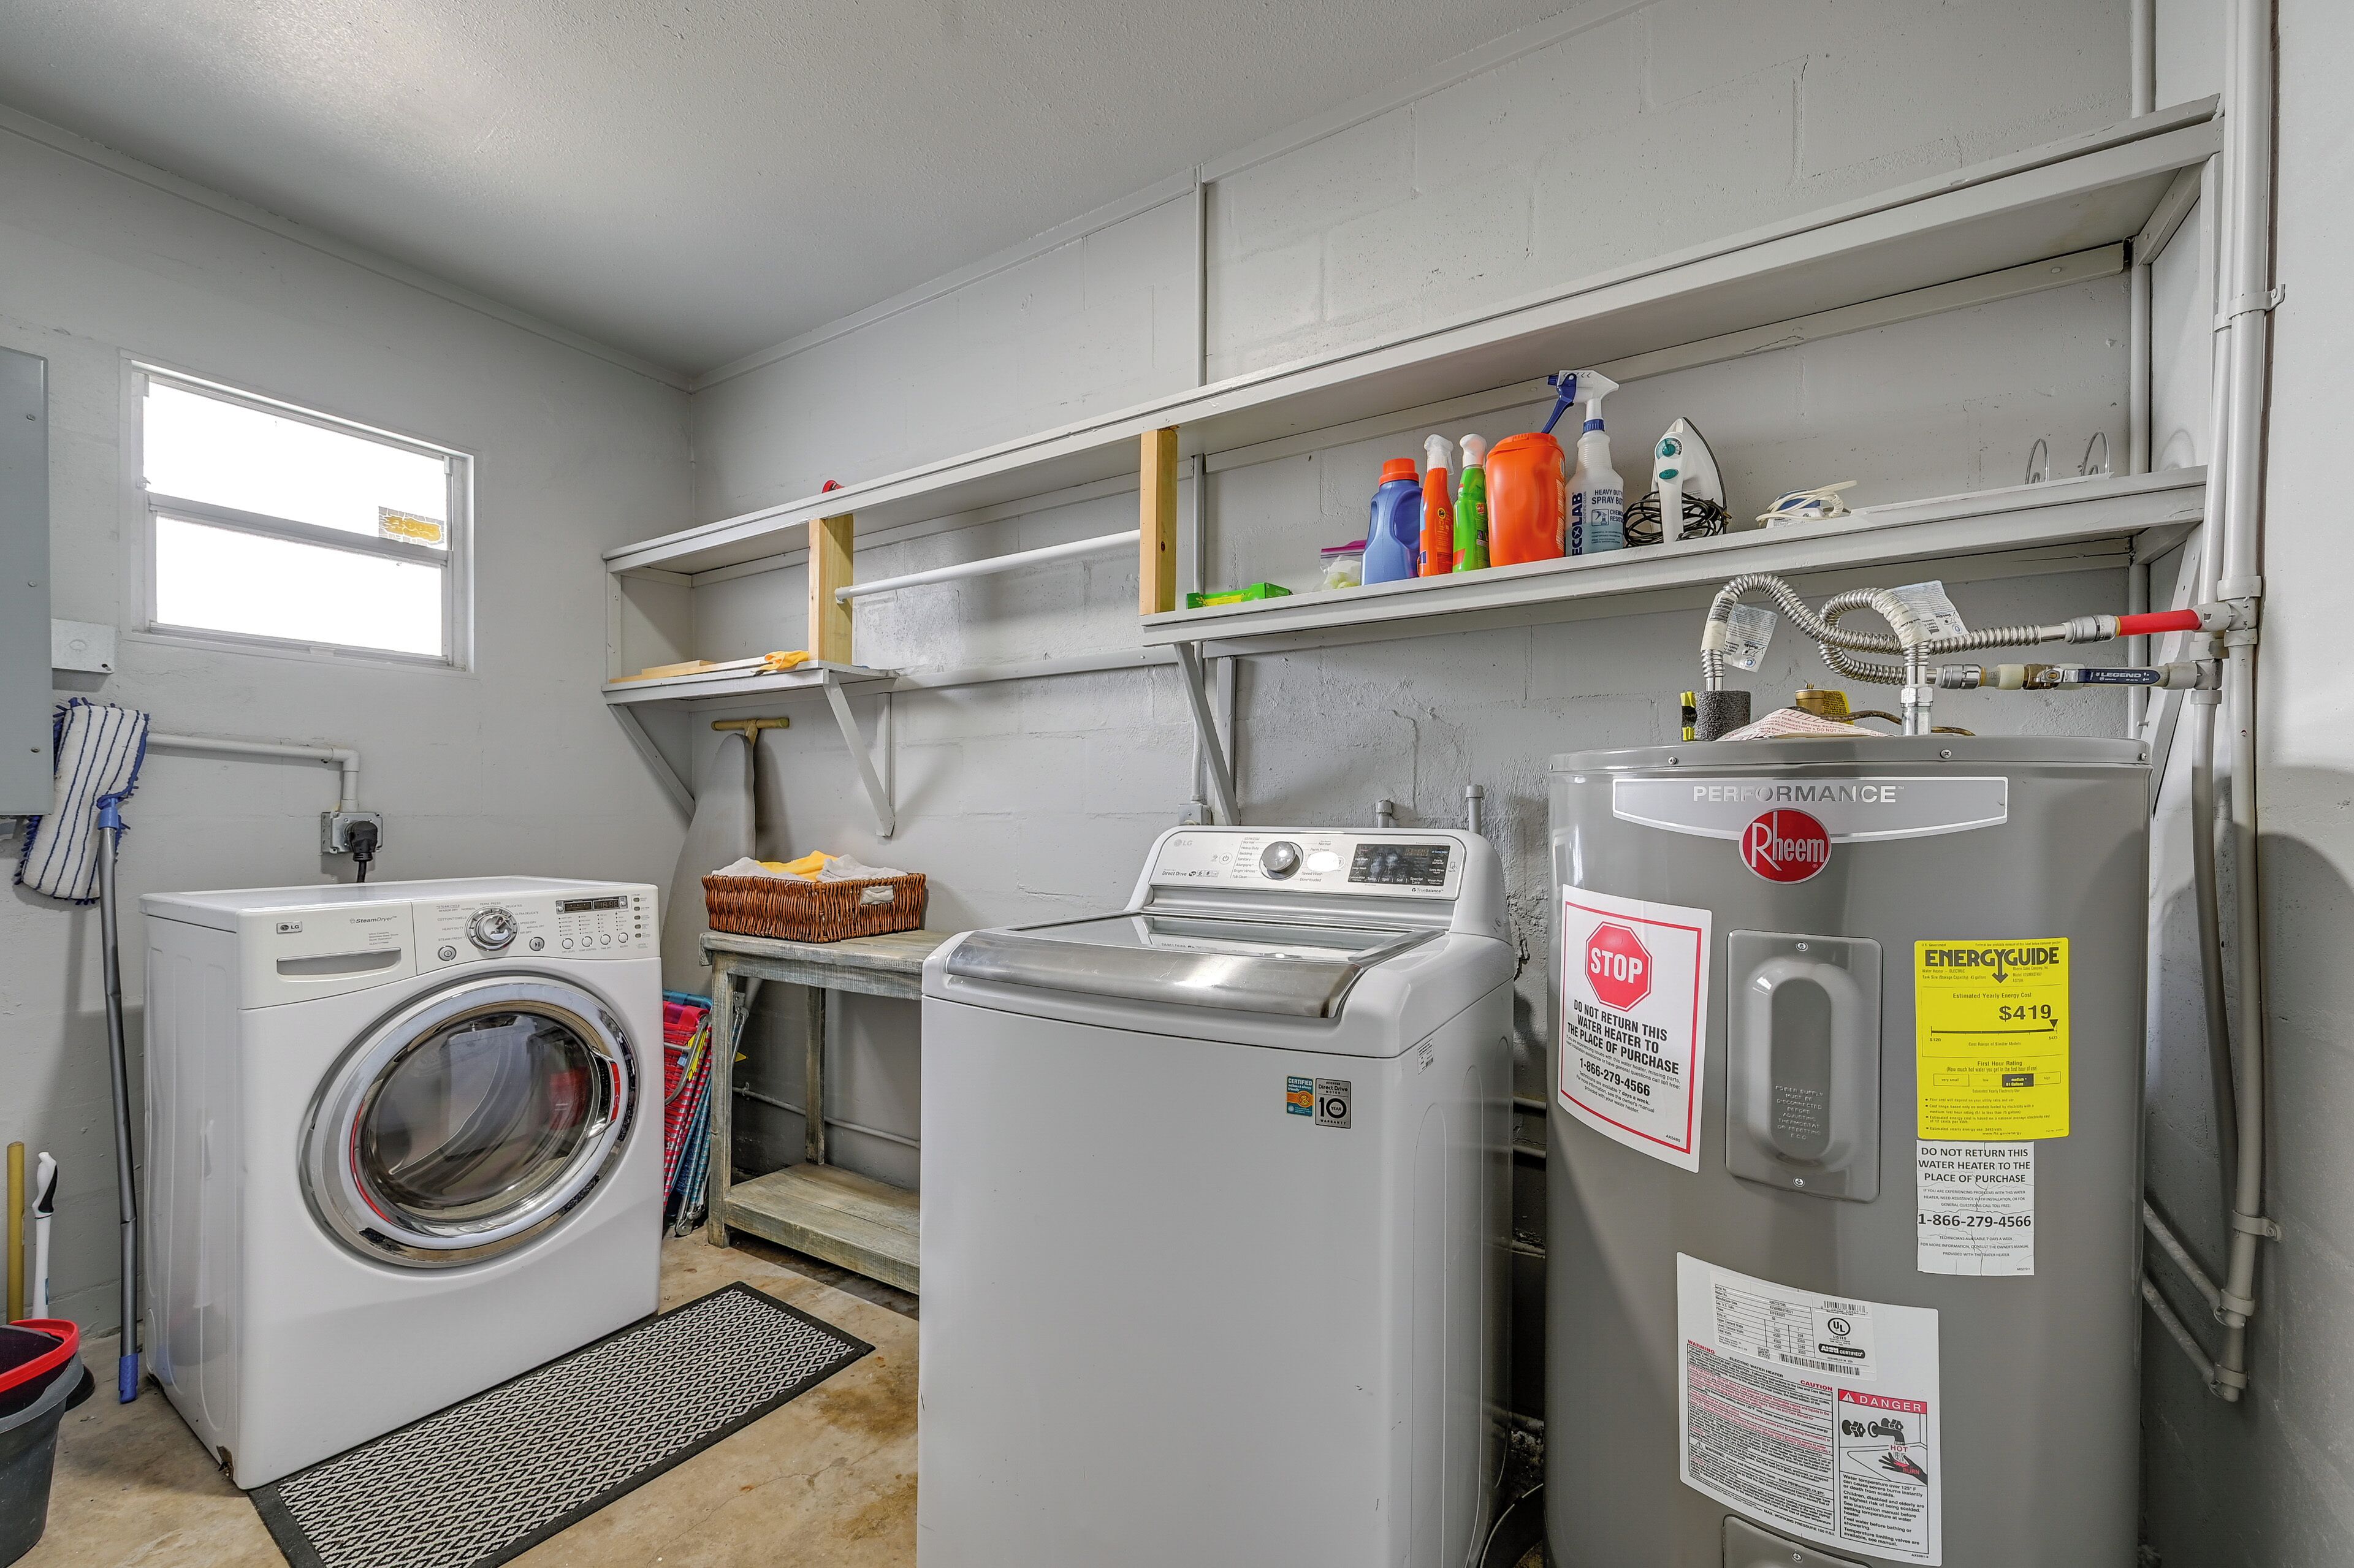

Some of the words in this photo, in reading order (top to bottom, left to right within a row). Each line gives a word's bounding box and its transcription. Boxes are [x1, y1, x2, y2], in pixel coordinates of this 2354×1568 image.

[1572, 493, 1582, 555] ECOLAB
[1693, 786, 1896, 803] PERFORMANCE
[1751, 811, 1824, 871] Rheem
[1590, 947, 1643, 984] STOP
[1925, 947, 2059, 973] ENERGYGUIDE
[1574, 999, 1582, 1012] DO
[1585, 1004, 1599, 1019] NOT
[1601, 1011, 1638, 1033] RETURN
[1642, 1024, 1667, 1041] THIS
[1999, 1004, 2051, 1022] $419
[1577, 1014, 1602, 1035] WATER
[1604, 1024, 1641, 1048] HEATER
[1645, 1040, 1659, 1053] TO
[1567, 1022, 1578, 1037] THE
[1580, 1029, 1603, 1049] PLACE
[1606, 1041, 1617, 1054] OF
[1621, 1046, 1679, 1075] PURCHASE
[1580, 1057, 1650, 1096] 1-866-279-4566
[1615, 1064, 1630, 1073] general
[1631, 1070, 1651, 1081] questions
[1632, 1064, 1647, 1073] heater,
[1648, 1070, 1666, 1079] missing
[1621, 1092, 1632, 1100] days
[1319, 1097, 1347, 1118] 10
[1639, 1103, 1655, 1113] manual
[1919, 1160, 1954, 1169] WATER
[1924, 1173, 1956, 1182] PLACE
[1918, 1214, 2031, 1227] 1-866-279-4566
[1834, 1321, 1845, 1333] UL
[1688, 1339, 1715, 1354] WARNING
[1729, 1357, 1750, 1366] ELECTRIC
[1800, 1380, 1833, 1391] CAUTION
[1860, 1396, 1921, 1412] DANGER
[1859, 1478, 1888, 1487] temperature
[1775, 1514, 1794, 1523] WORKING
[1795, 1521, 1816, 1531] PRESSURE
[1844, 1521, 1871, 1530] showering.
[1844, 1527, 1875, 1537] Temperature
